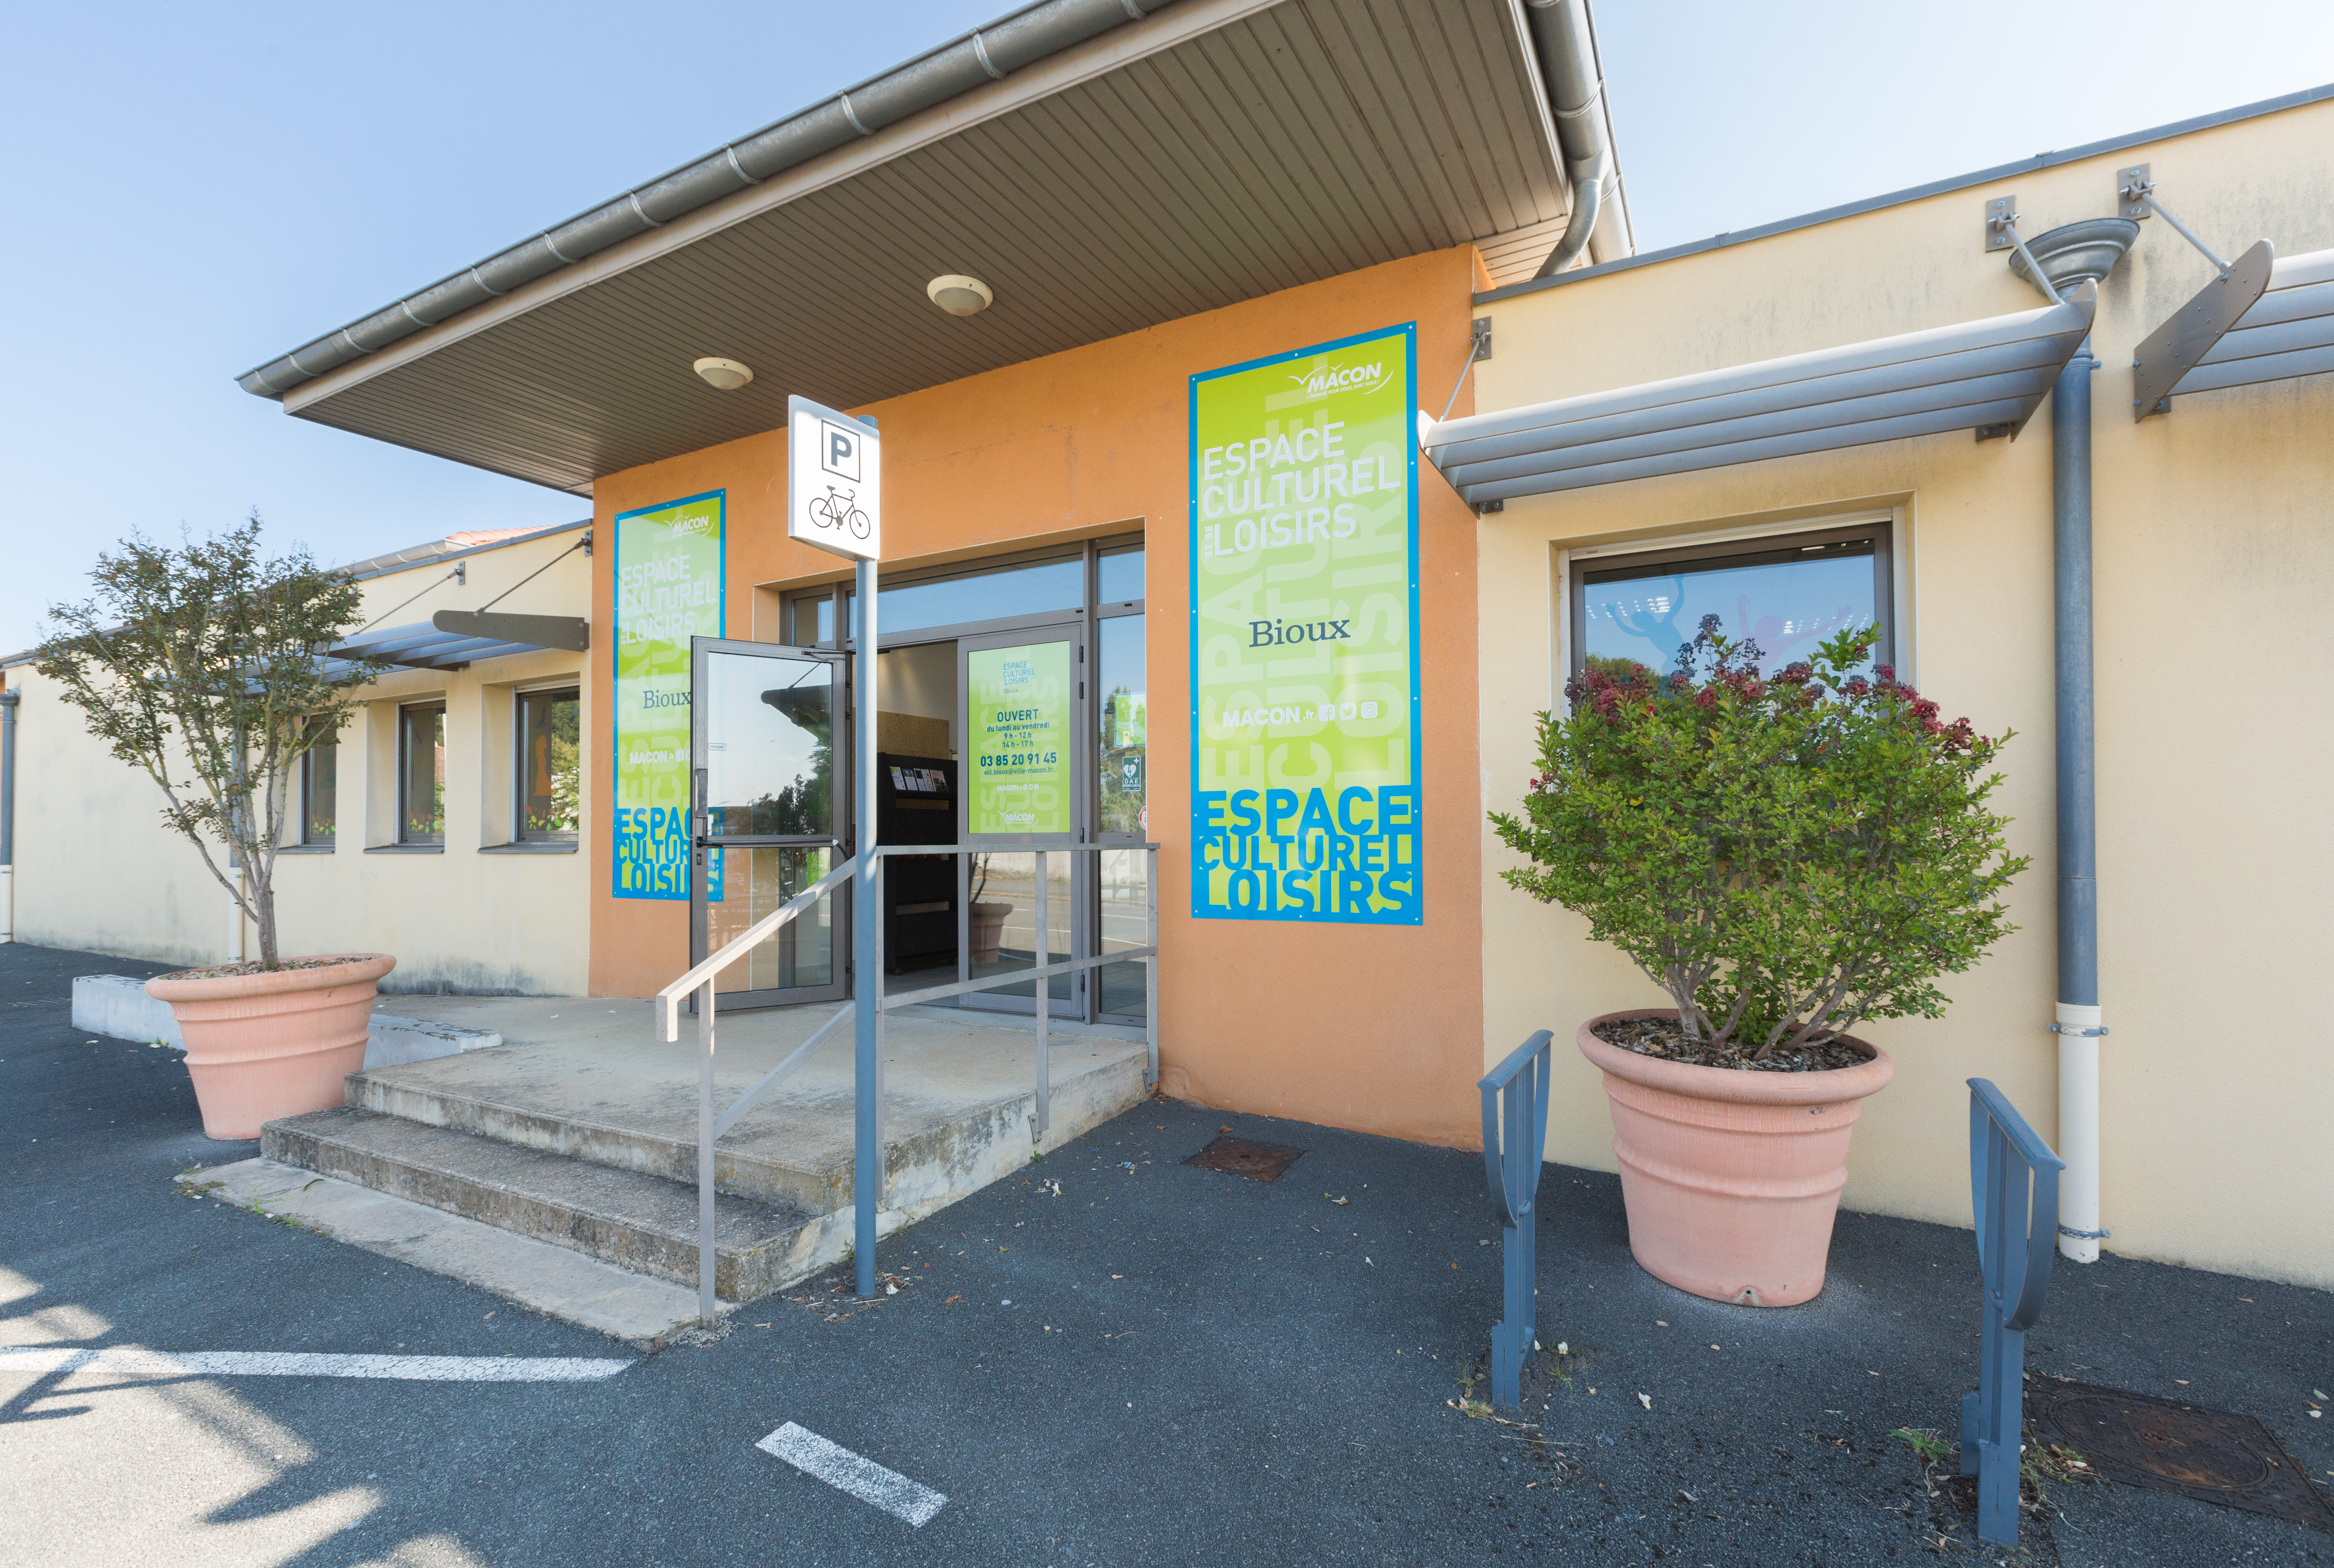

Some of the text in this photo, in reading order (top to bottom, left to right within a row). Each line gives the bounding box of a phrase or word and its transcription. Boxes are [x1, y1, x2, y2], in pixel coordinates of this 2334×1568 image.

[831, 431, 852, 467] P
[1204, 421, 1344, 481] ESPACE
[1204, 455, 1401, 518] CULTUREL
[1215, 503, 1356, 556] LOISIRS
[622, 555, 691, 590] ESPACE
[621, 579, 717, 617] CULTUREL
[627, 611, 696, 644] LOISIRS
[1249, 618, 1351, 648] Bioux
[1003, 661, 1027, 670] ESPACE
[1003, 668, 1036, 678] CULTUREL
[1005, 676, 1029, 685] LOISIRS
[643, 690, 691, 709] Bioux
[997, 709, 1039, 722] OUVERT
[981, 752, 1057, 767] 03 85 20 91 45
[984, 767, 1053, 775] ecl.bioux@ville-macon.fr
[1199, 784, 1411, 837] ESPACE
[1199, 834, 1412, 872] CULTUREL
[1199, 870, 1412, 914] LOISIRS
